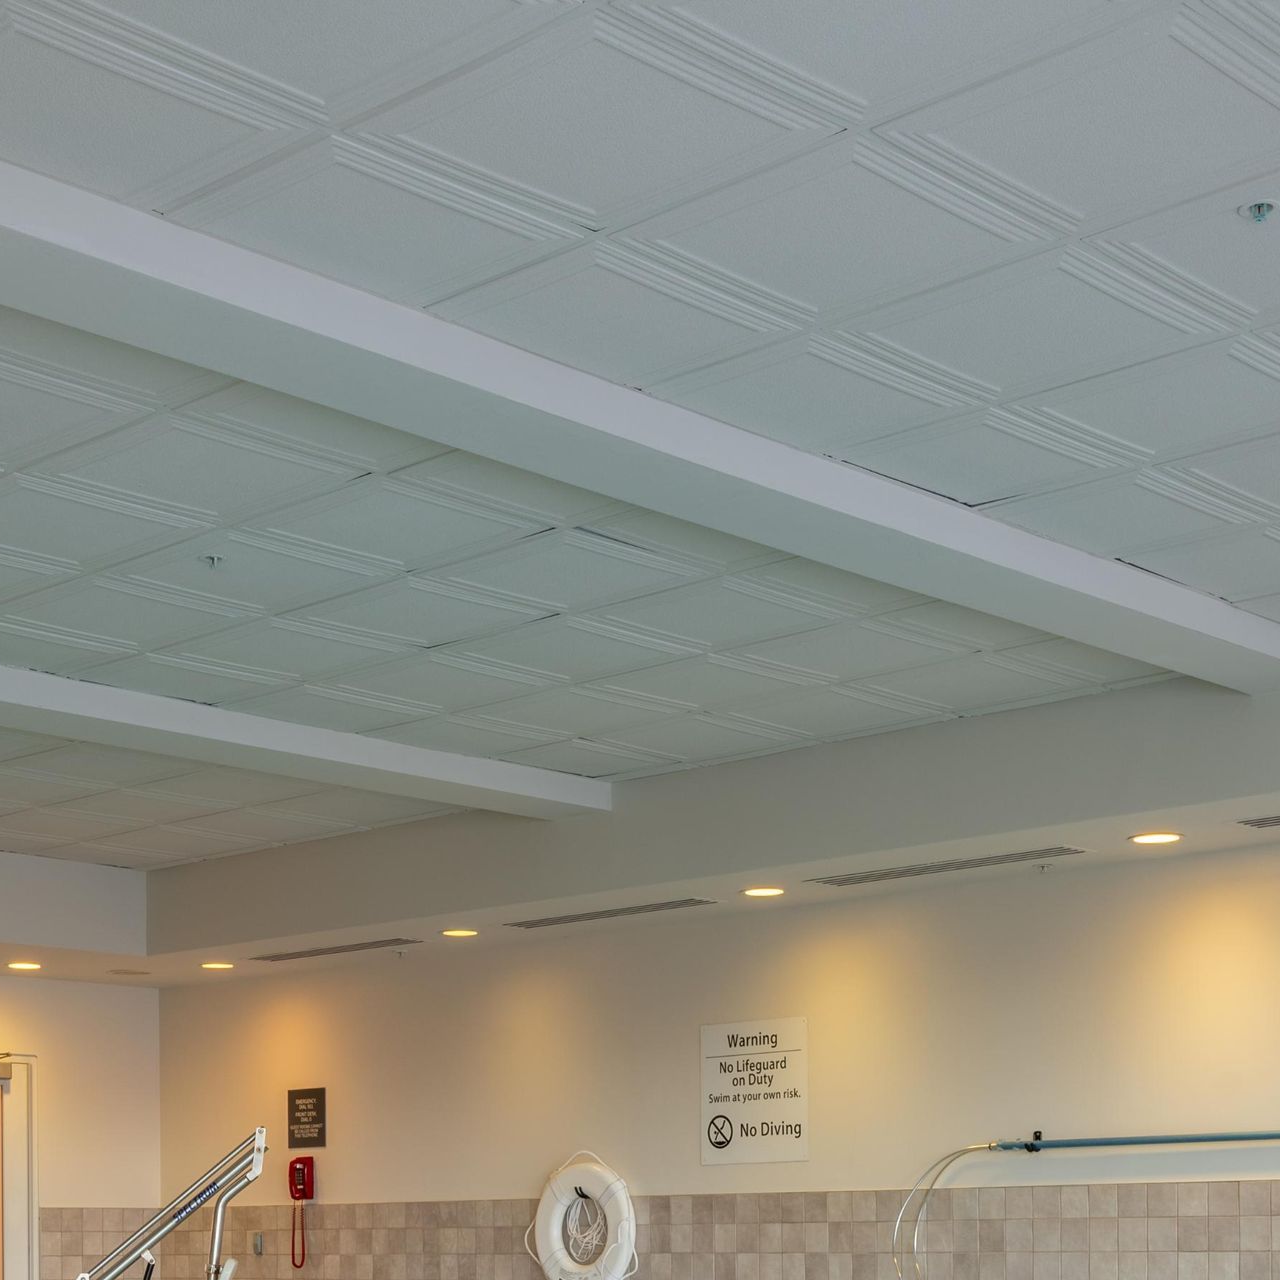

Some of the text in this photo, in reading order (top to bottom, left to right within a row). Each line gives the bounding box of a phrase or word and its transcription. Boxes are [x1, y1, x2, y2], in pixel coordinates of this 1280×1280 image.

[727, 1032, 778, 1048] Warning
[720, 1056, 787, 1074] No Lifeguard
[732, 1073, 774, 1087] on Duty
[708, 1088, 801, 1104] Swim at your own risk.
[740, 1120, 802, 1139] No Diving
